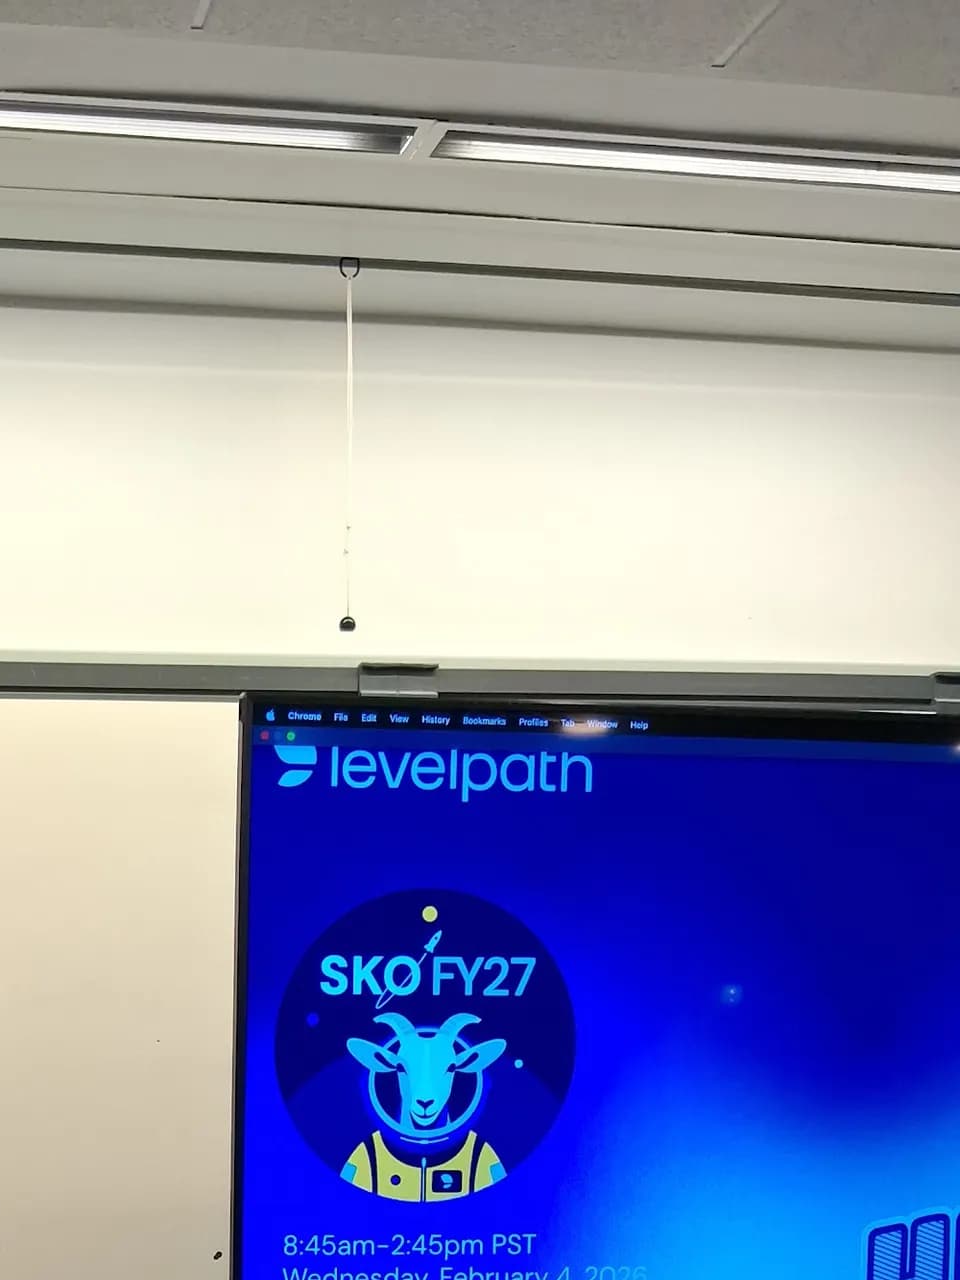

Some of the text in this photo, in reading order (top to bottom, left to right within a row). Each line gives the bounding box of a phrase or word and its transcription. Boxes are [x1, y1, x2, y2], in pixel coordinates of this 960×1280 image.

[287, 711, 649, 730] Chrome File Edit View History Bookmarks Profiles Tab Window Help
[330, 745, 593, 803] levelpath
[319, 954, 537, 997] SKO FY27
[491, 1232, 537, 1255] PST
